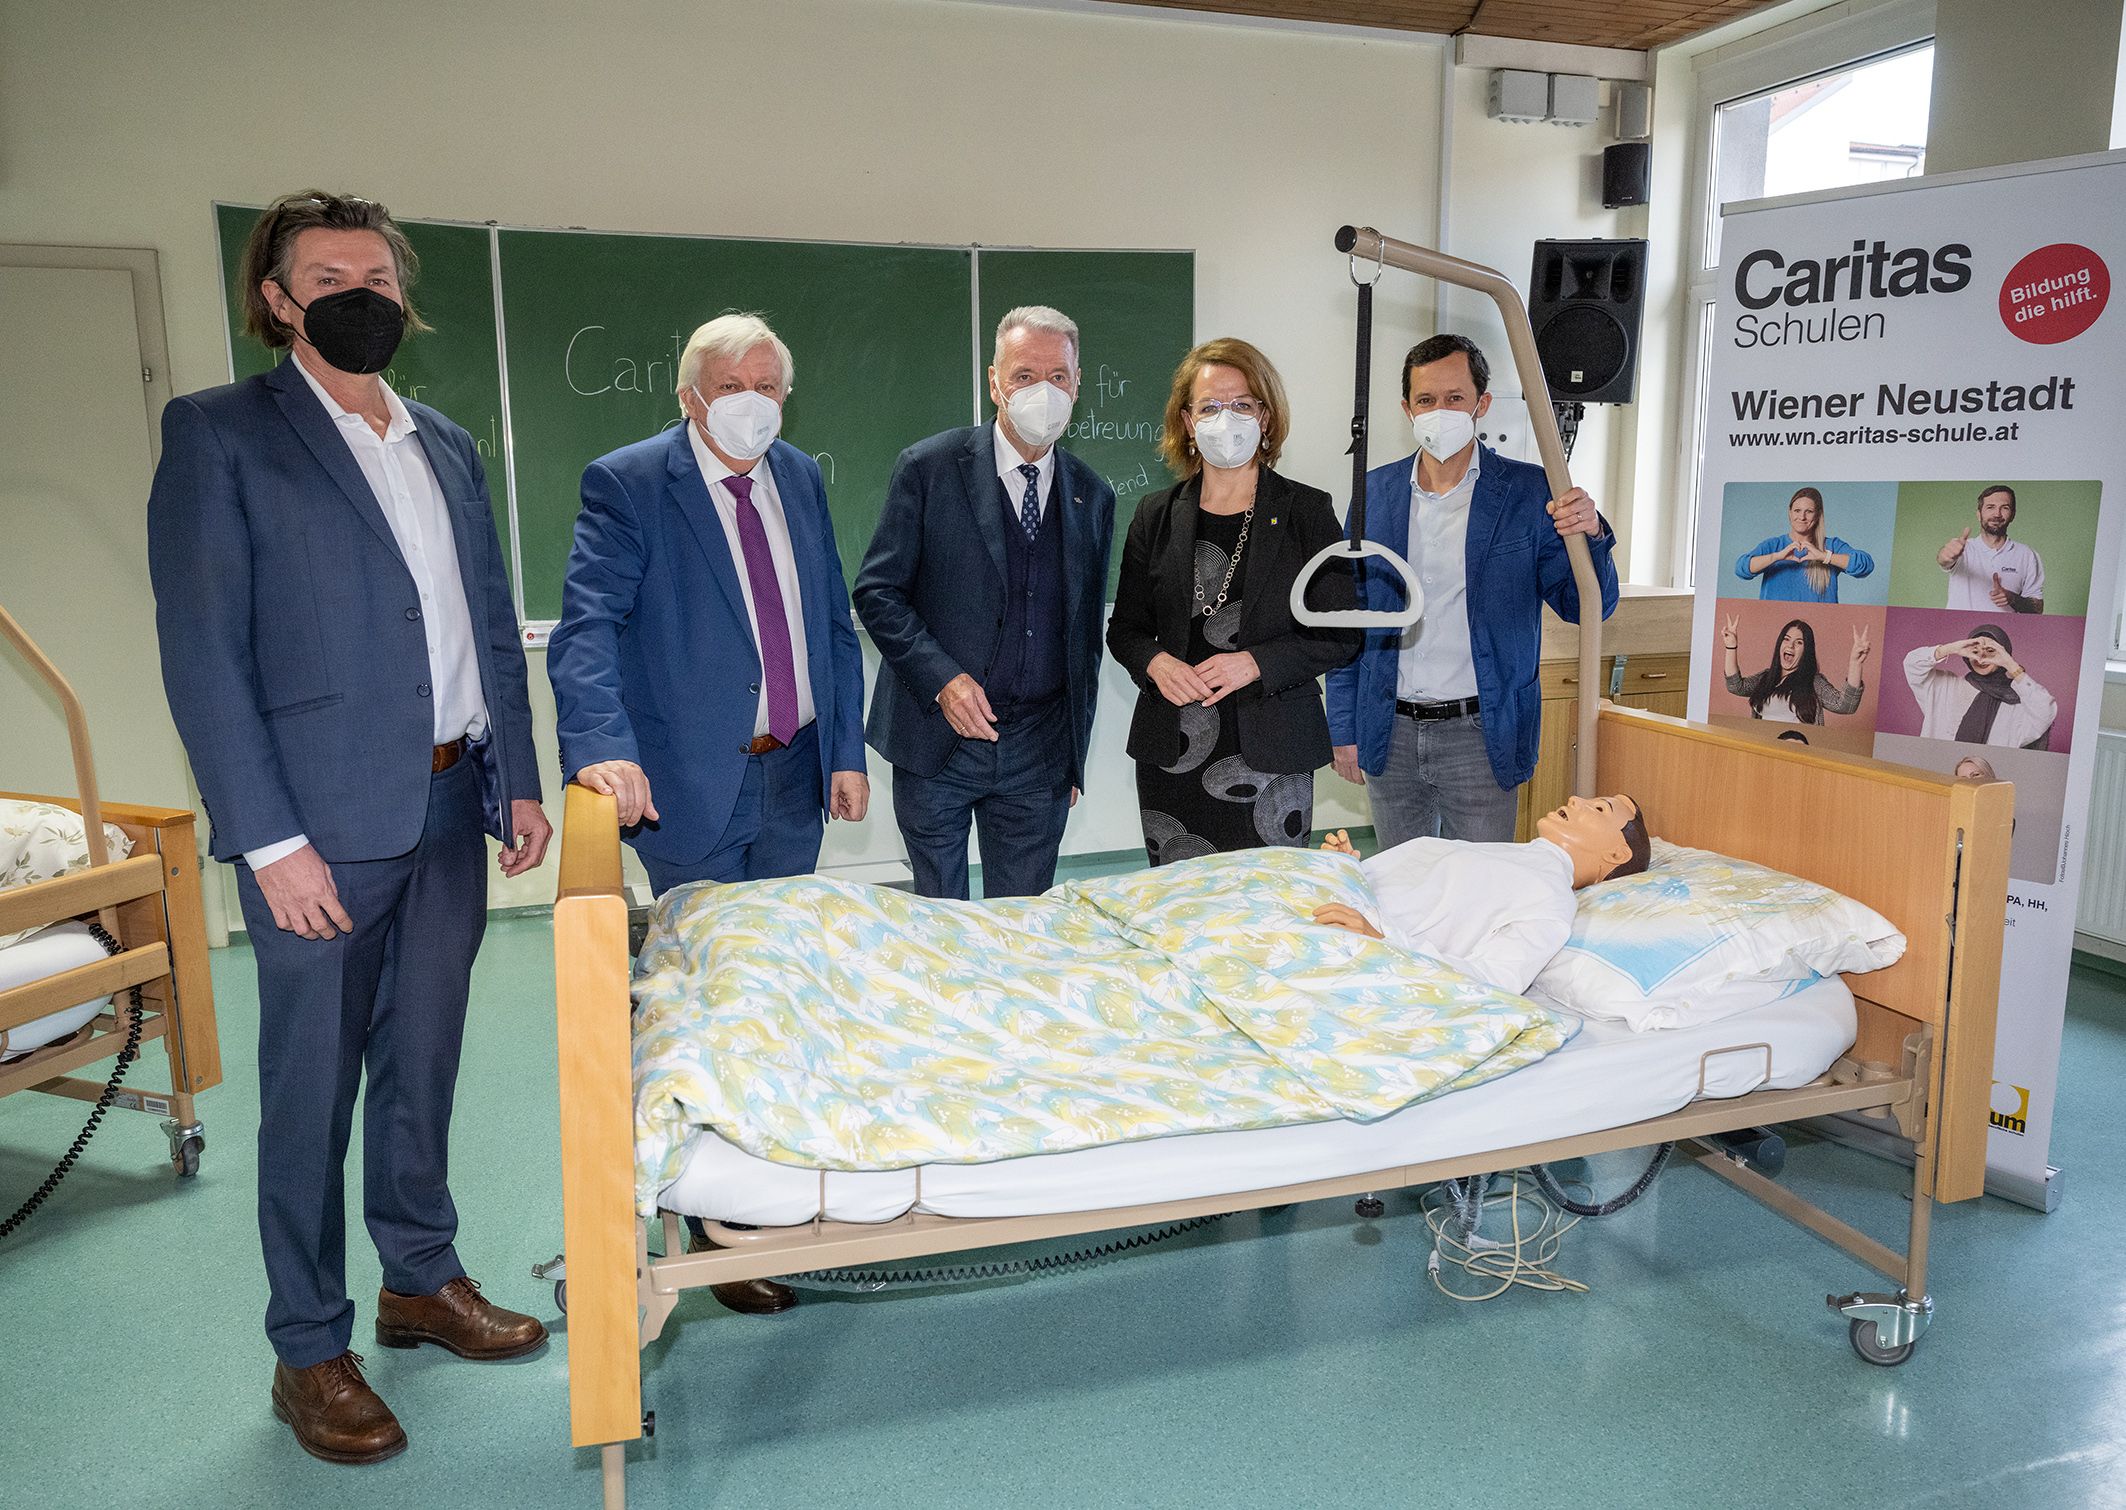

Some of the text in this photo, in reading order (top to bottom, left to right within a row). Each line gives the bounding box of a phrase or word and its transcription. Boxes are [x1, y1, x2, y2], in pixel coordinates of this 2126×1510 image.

[1735, 240, 1972, 310] Caritas
[2011, 268, 2091, 304] Bildung
[2015, 287, 2098, 323] die hilft.
[1734, 308, 1885, 348] Schulen
[1096, 364, 1132, 408] für
[1731, 376, 2076, 421] Wiener Neustadt
[1729, 422, 2019, 447] www.wn.caritas-schule.at
[2027, 898, 2049, 913] HH,
